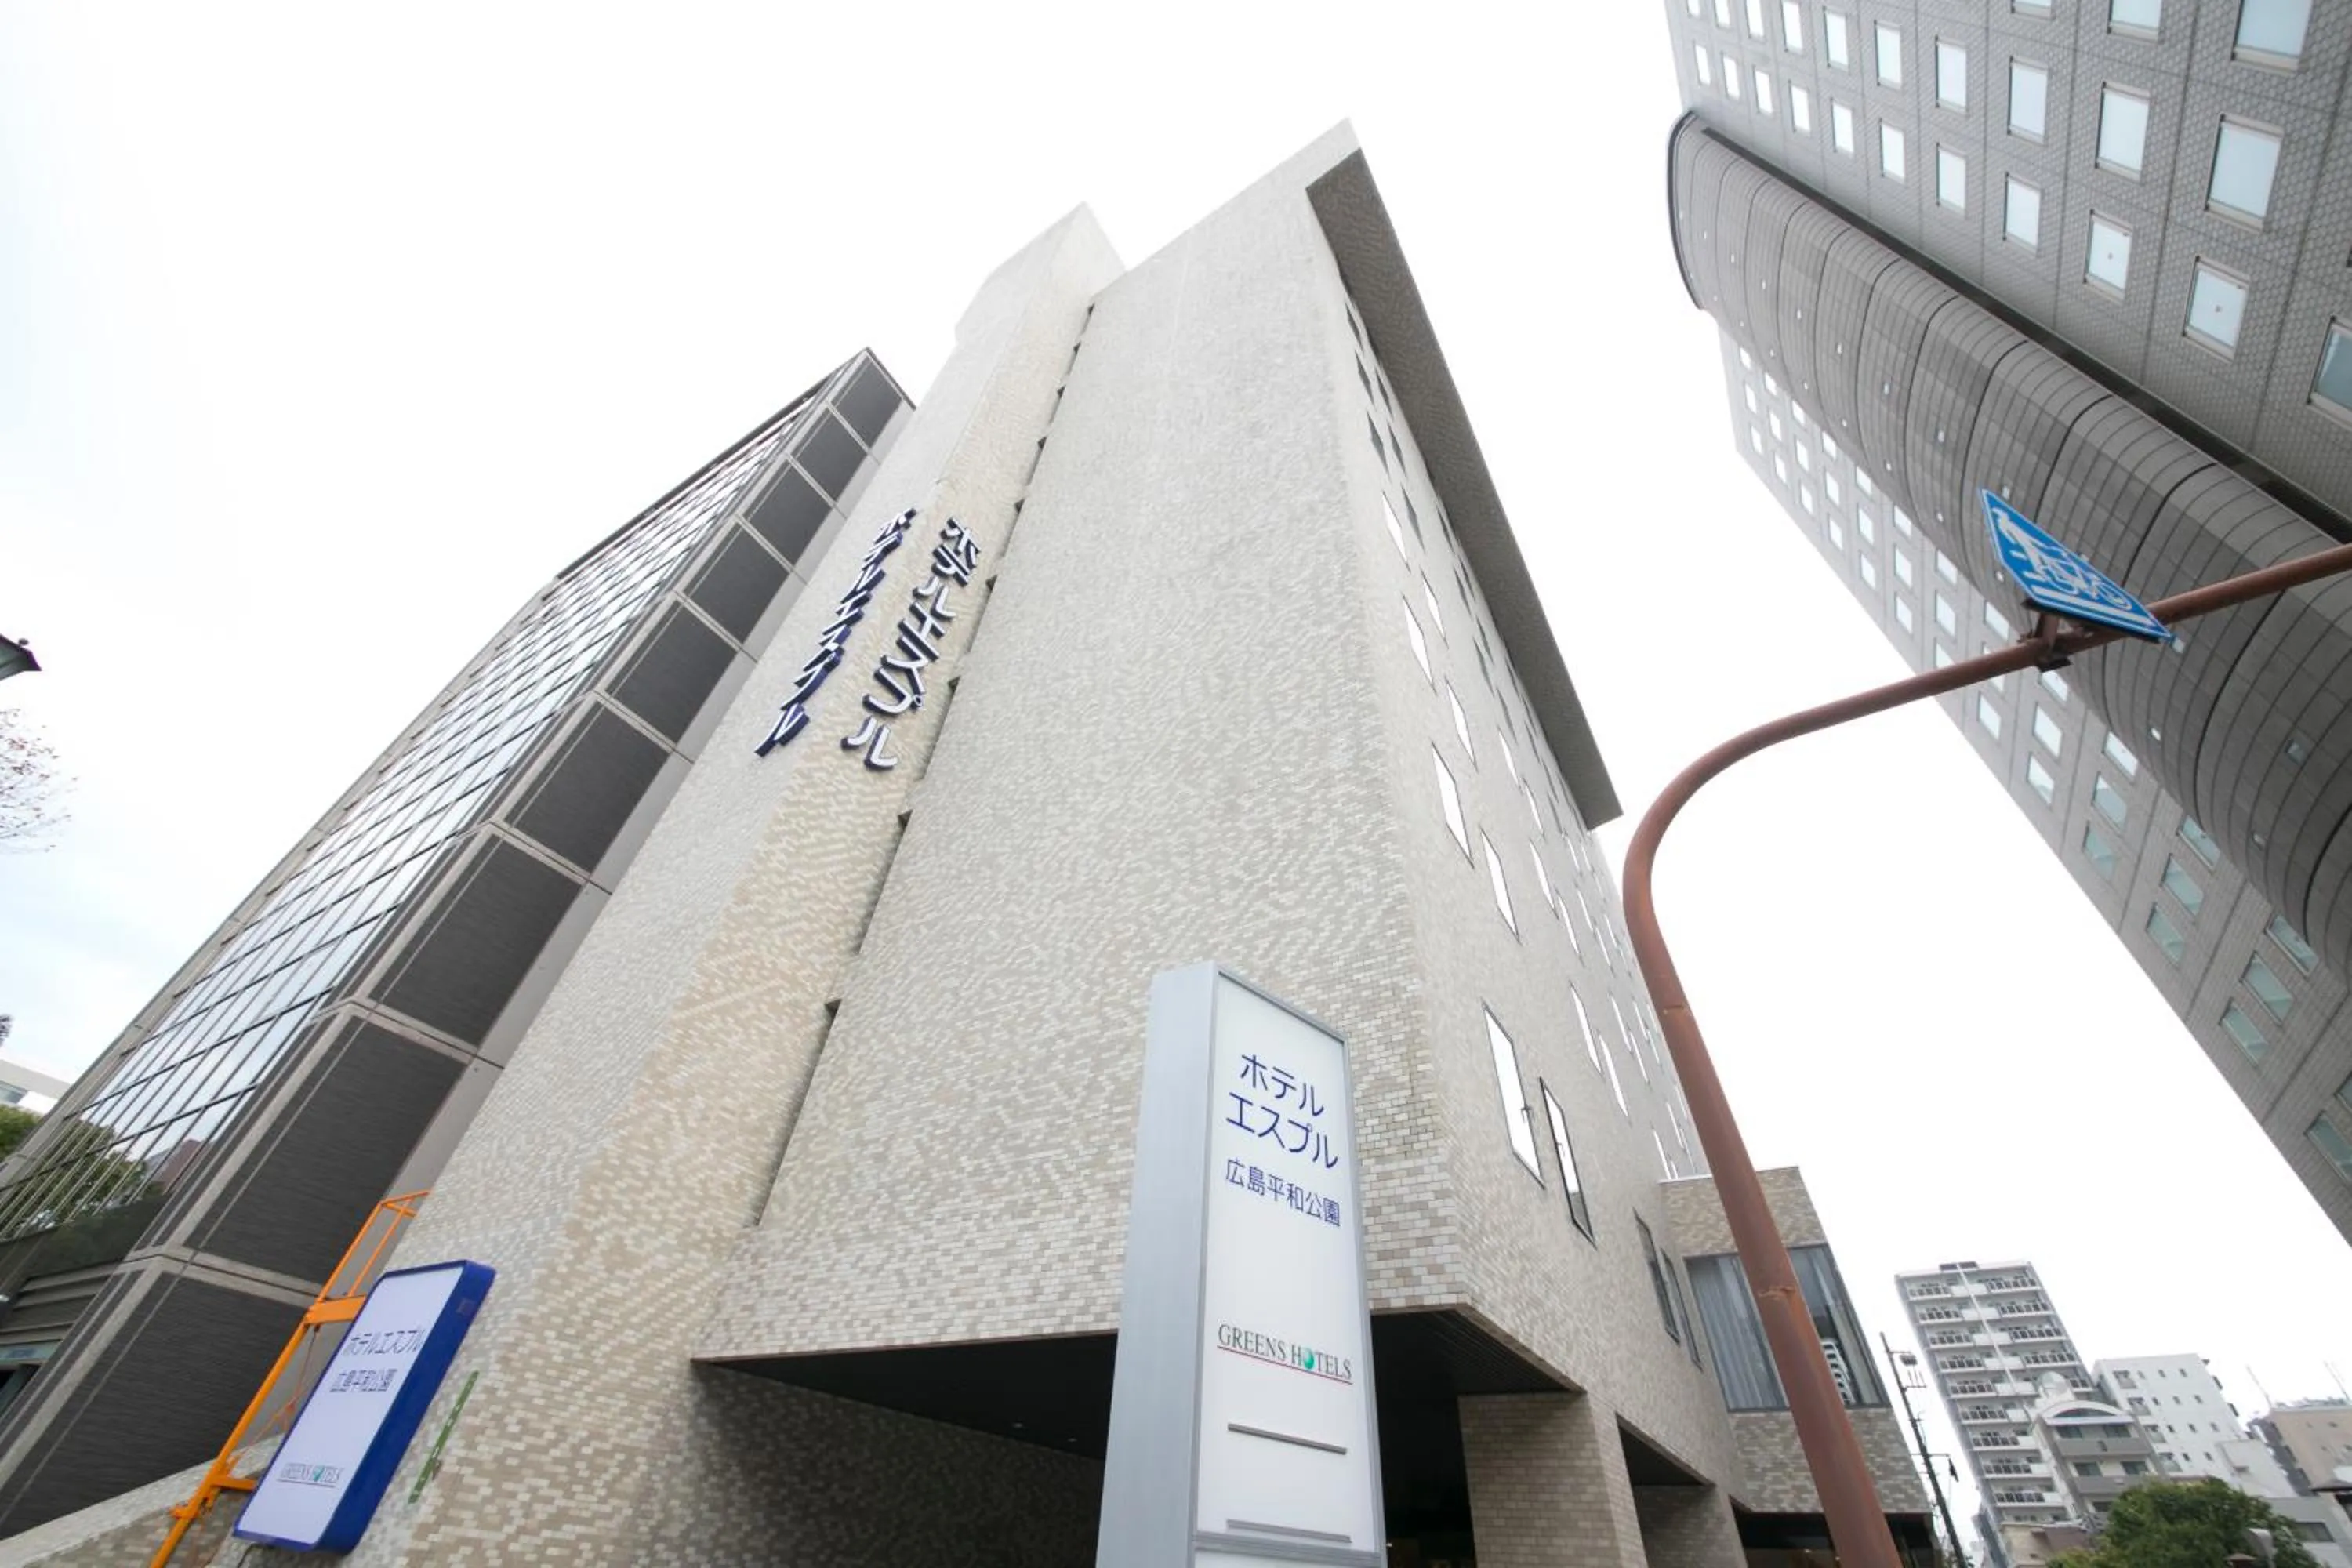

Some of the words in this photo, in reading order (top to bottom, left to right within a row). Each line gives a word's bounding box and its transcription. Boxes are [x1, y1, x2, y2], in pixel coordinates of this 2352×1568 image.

[840, 517, 981, 771] ホテルエスプル
[1240, 1054, 1324, 1116] ホテル
[1225, 1091, 1339, 1168] エスプル
[1225, 1156, 1341, 1227] 広島平和公園
[1218, 1323, 1286, 1362] GREENS
[1290, 1343, 1352, 1380] HOTELS
